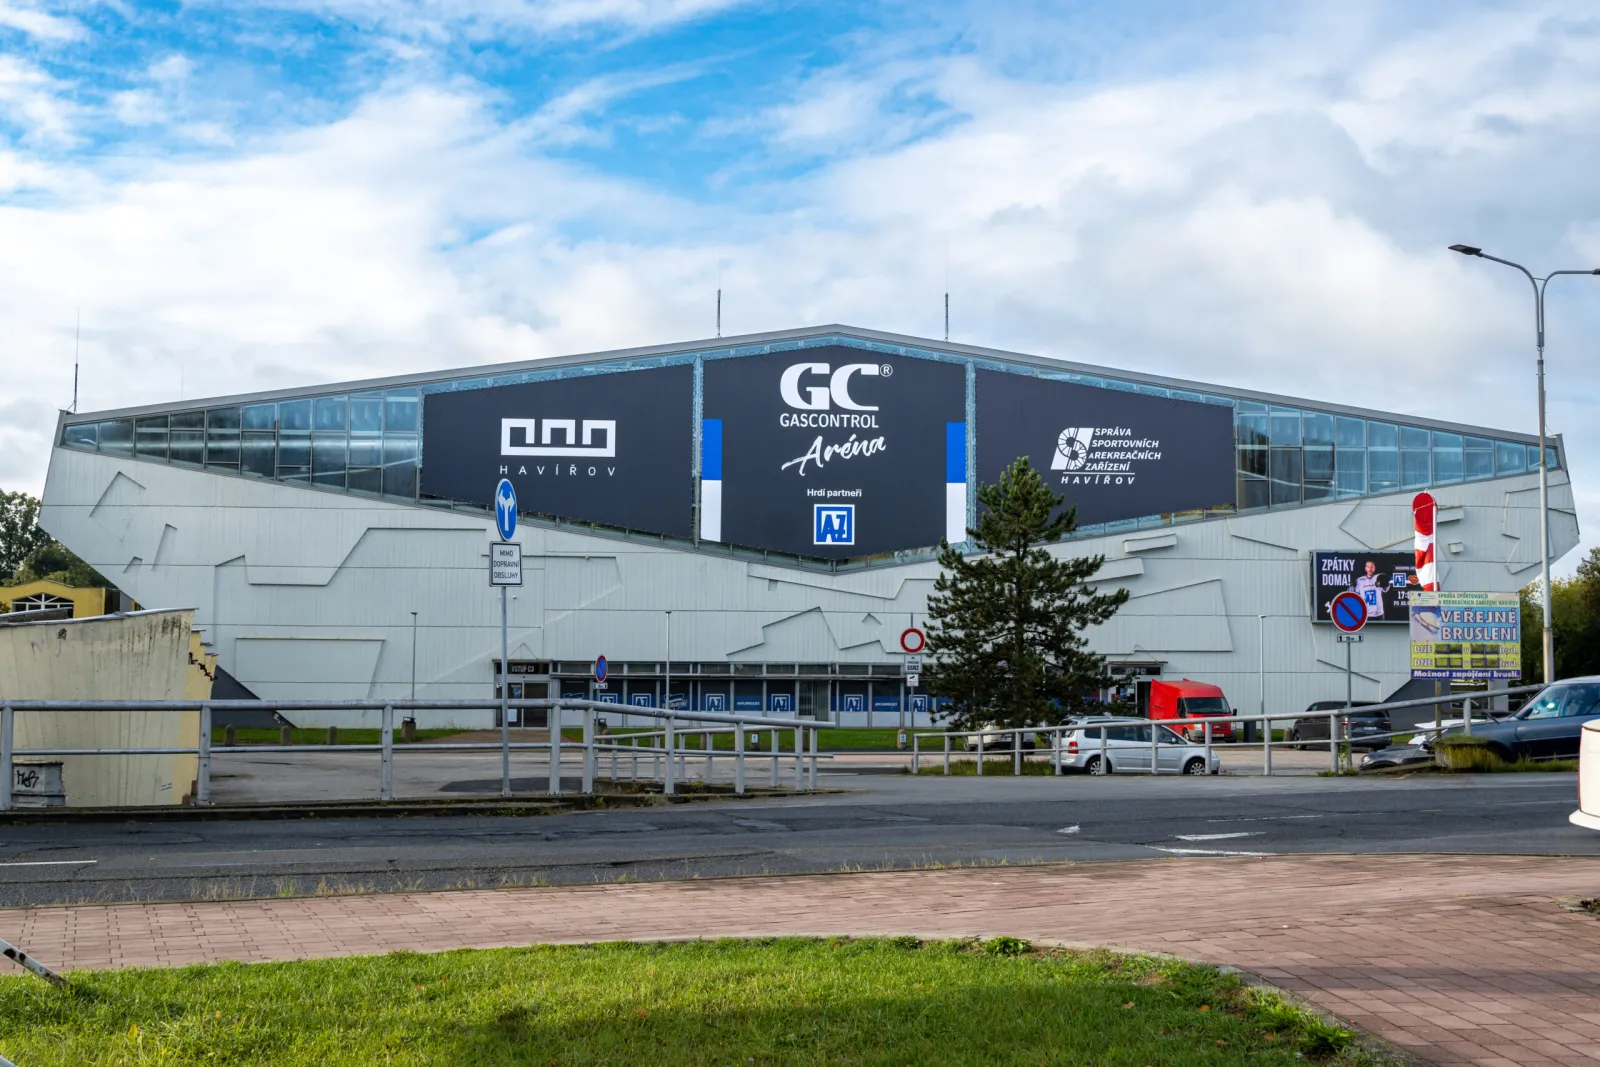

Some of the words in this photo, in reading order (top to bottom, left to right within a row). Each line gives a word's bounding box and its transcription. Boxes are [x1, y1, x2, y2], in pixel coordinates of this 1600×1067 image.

[780, 413, 879, 428] GASCONTROL
[1095, 426, 1131, 436] SPRÁVA
[1092, 438, 1159, 448] SPORTOVNÍCH
[781, 434, 887, 477] Aréna
[1094, 450, 1162, 460] REKREAČNÍCH
[500, 464, 616, 476] HAVÍŘOV
[1085, 461, 1131, 471] ZAŘÍZENÍ
[1061, 475, 1135, 485] HAVÍŘOV
[807, 488, 826, 497] Hrdí
[827, 488, 862, 498] partneři
[493, 560, 520, 568] DOPRAVNÍ
[1322, 557, 1355, 571] ZPÁTKY
[493, 571, 519, 579] OBSLUHY
[1322, 574, 1351, 586] DOMA!
[1441, 607, 1517, 623] VEŘEJNÉ
[1442, 624, 1517, 640] BRUSLENÍ
[1414, 645, 1433, 653] DNE
[1414, 658, 1433, 667] DNE
